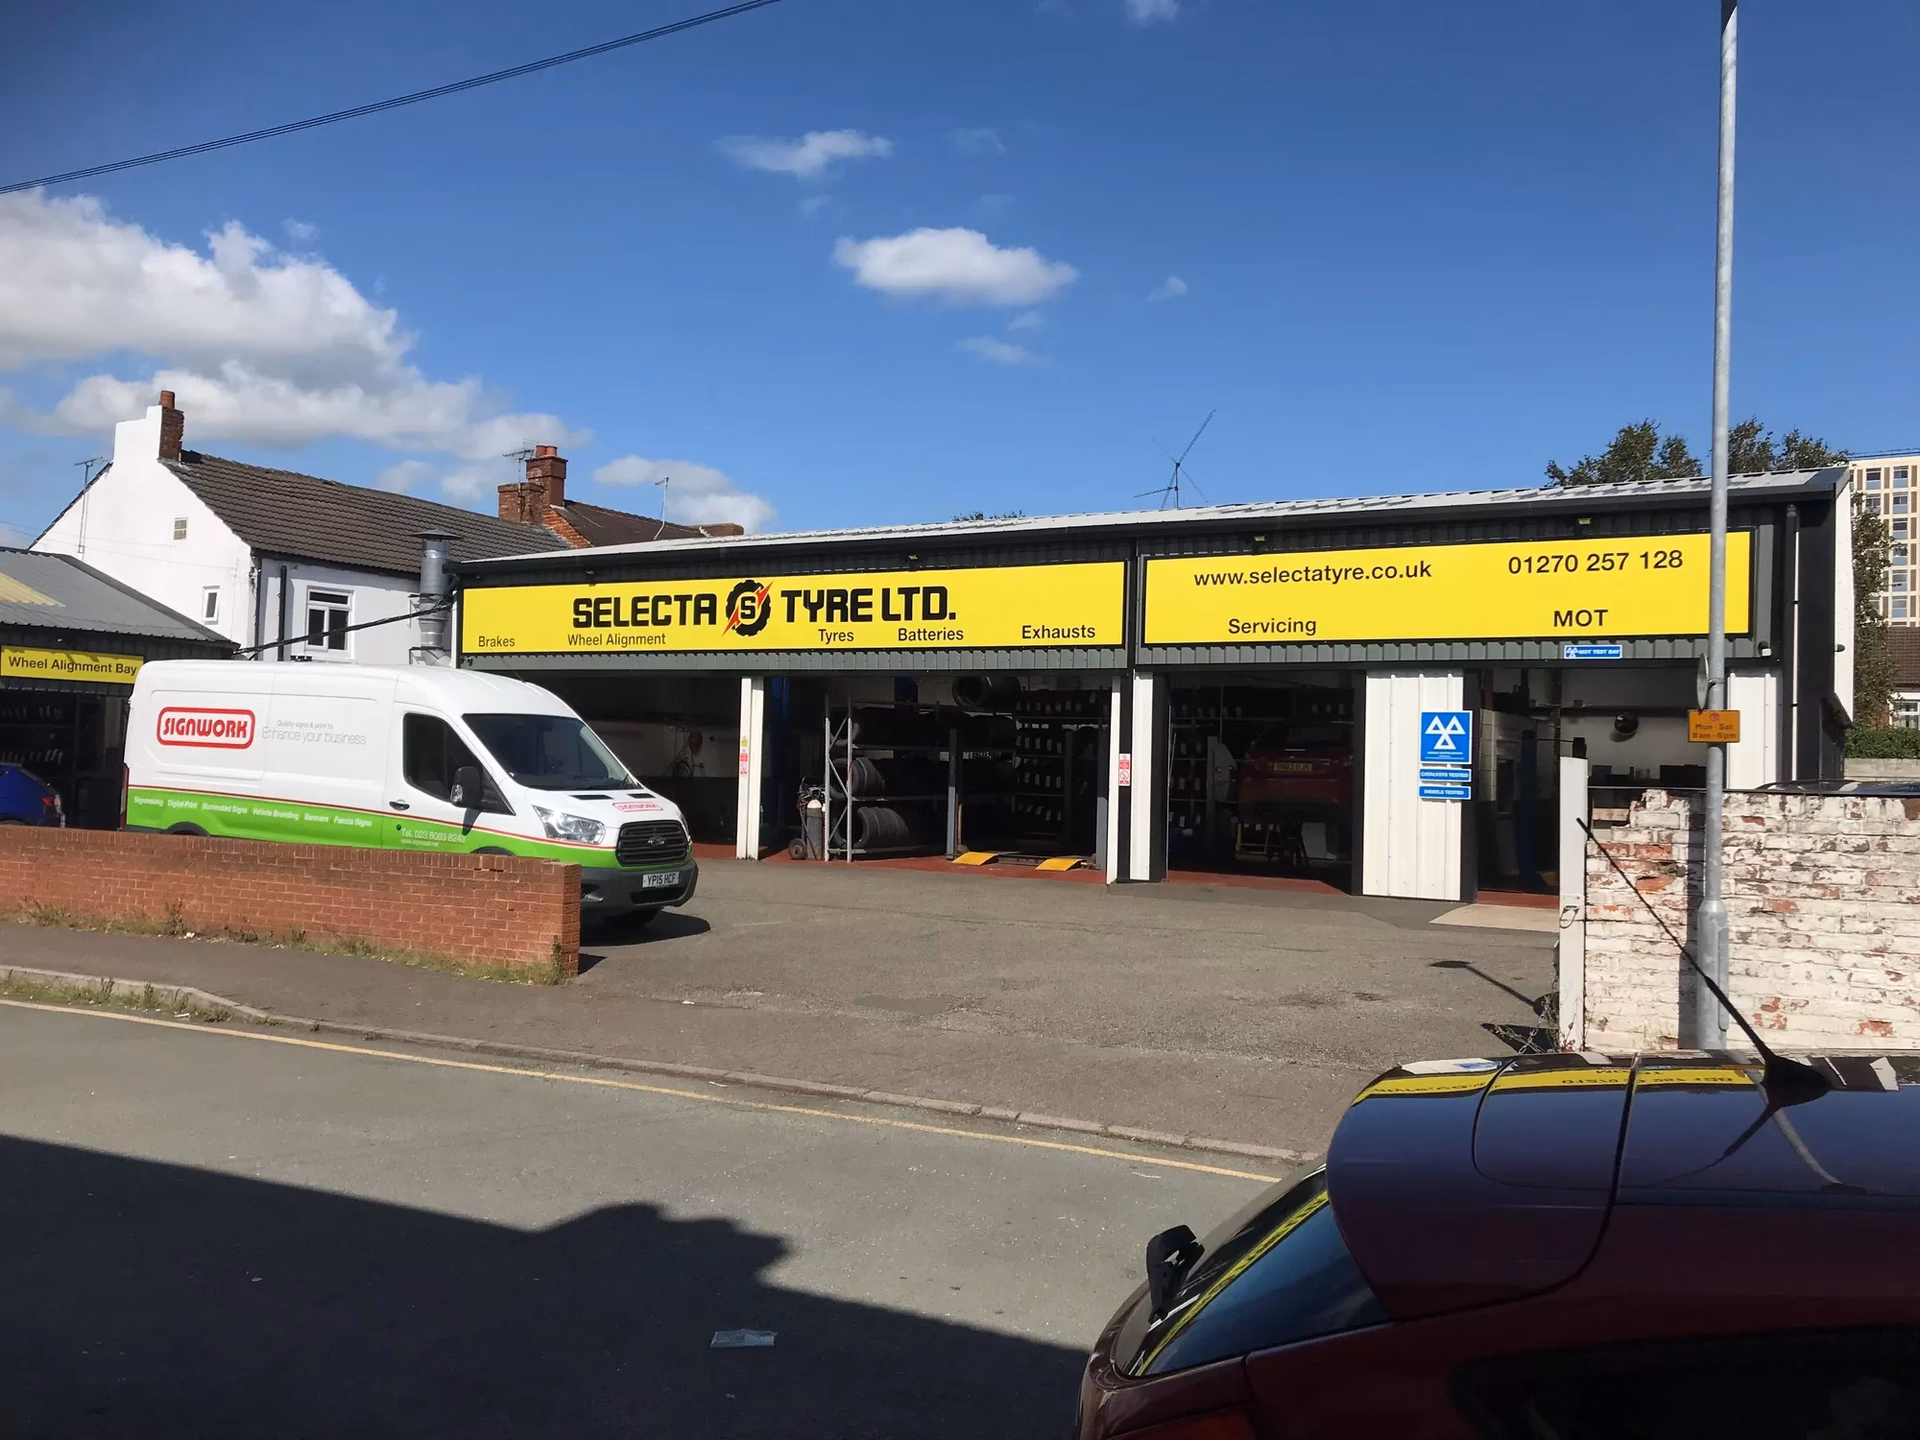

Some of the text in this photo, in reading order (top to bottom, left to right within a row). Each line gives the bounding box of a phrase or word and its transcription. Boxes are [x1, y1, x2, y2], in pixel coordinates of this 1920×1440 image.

[1508, 549, 1683, 575] 01270 257 128
[1193, 560, 1432, 586] www.selectatyre.co.uk
[572, 592, 718, 629] SELECTA
[781, 587, 874, 623] TYRE
[881, 585, 957, 622] LTD.
[1228, 617, 1317, 636] Servicing
[1553, 609, 1608, 628] MOT
[567, 632, 666, 648] Wheel Alignment
[818, 628, 854, 645] Tyres
[898, 626, 964, 643] Batteries
[1021, 623, 1096, 639] Exhausts
[478, 635, 516, 648] Brakes
[9, 656, 138, 676] Wheel Alignment Bay
[162, 717, 248, 739] SIGNWORK
[262, 727, 367, 745] Enhance your business
[647, 874, 663, 886] YP15
